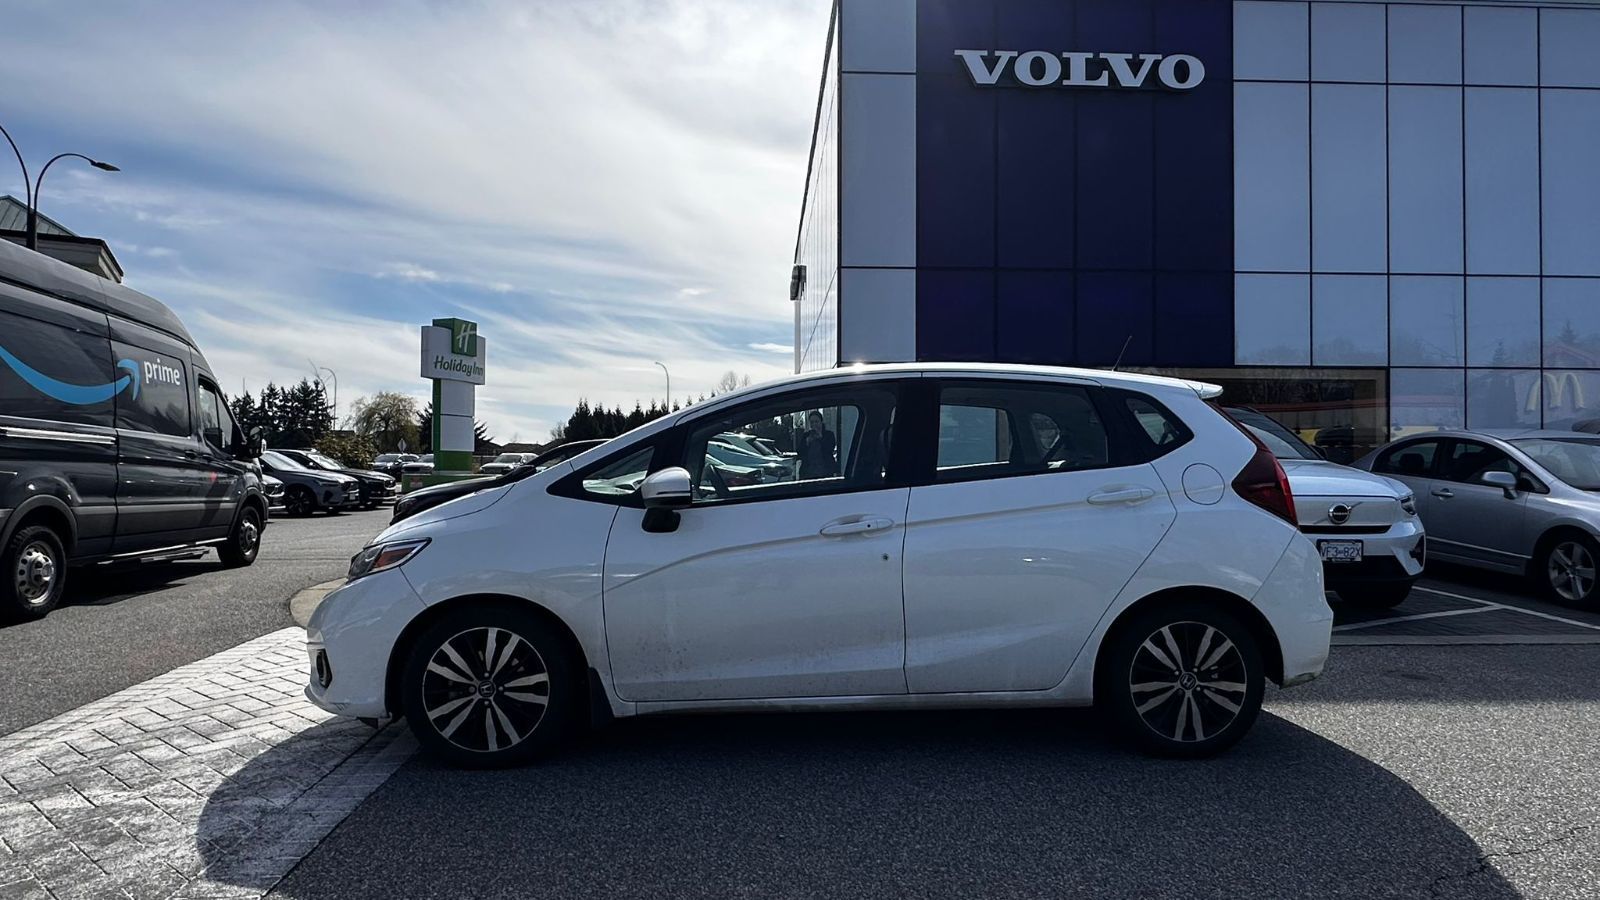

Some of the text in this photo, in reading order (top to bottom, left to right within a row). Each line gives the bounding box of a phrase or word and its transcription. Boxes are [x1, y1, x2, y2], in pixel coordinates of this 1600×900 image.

[954, 49, 1206, 90] VOLVO
[143, 358, 181, 386] prime
[433, 355, 483, 376] Holiday Inn
